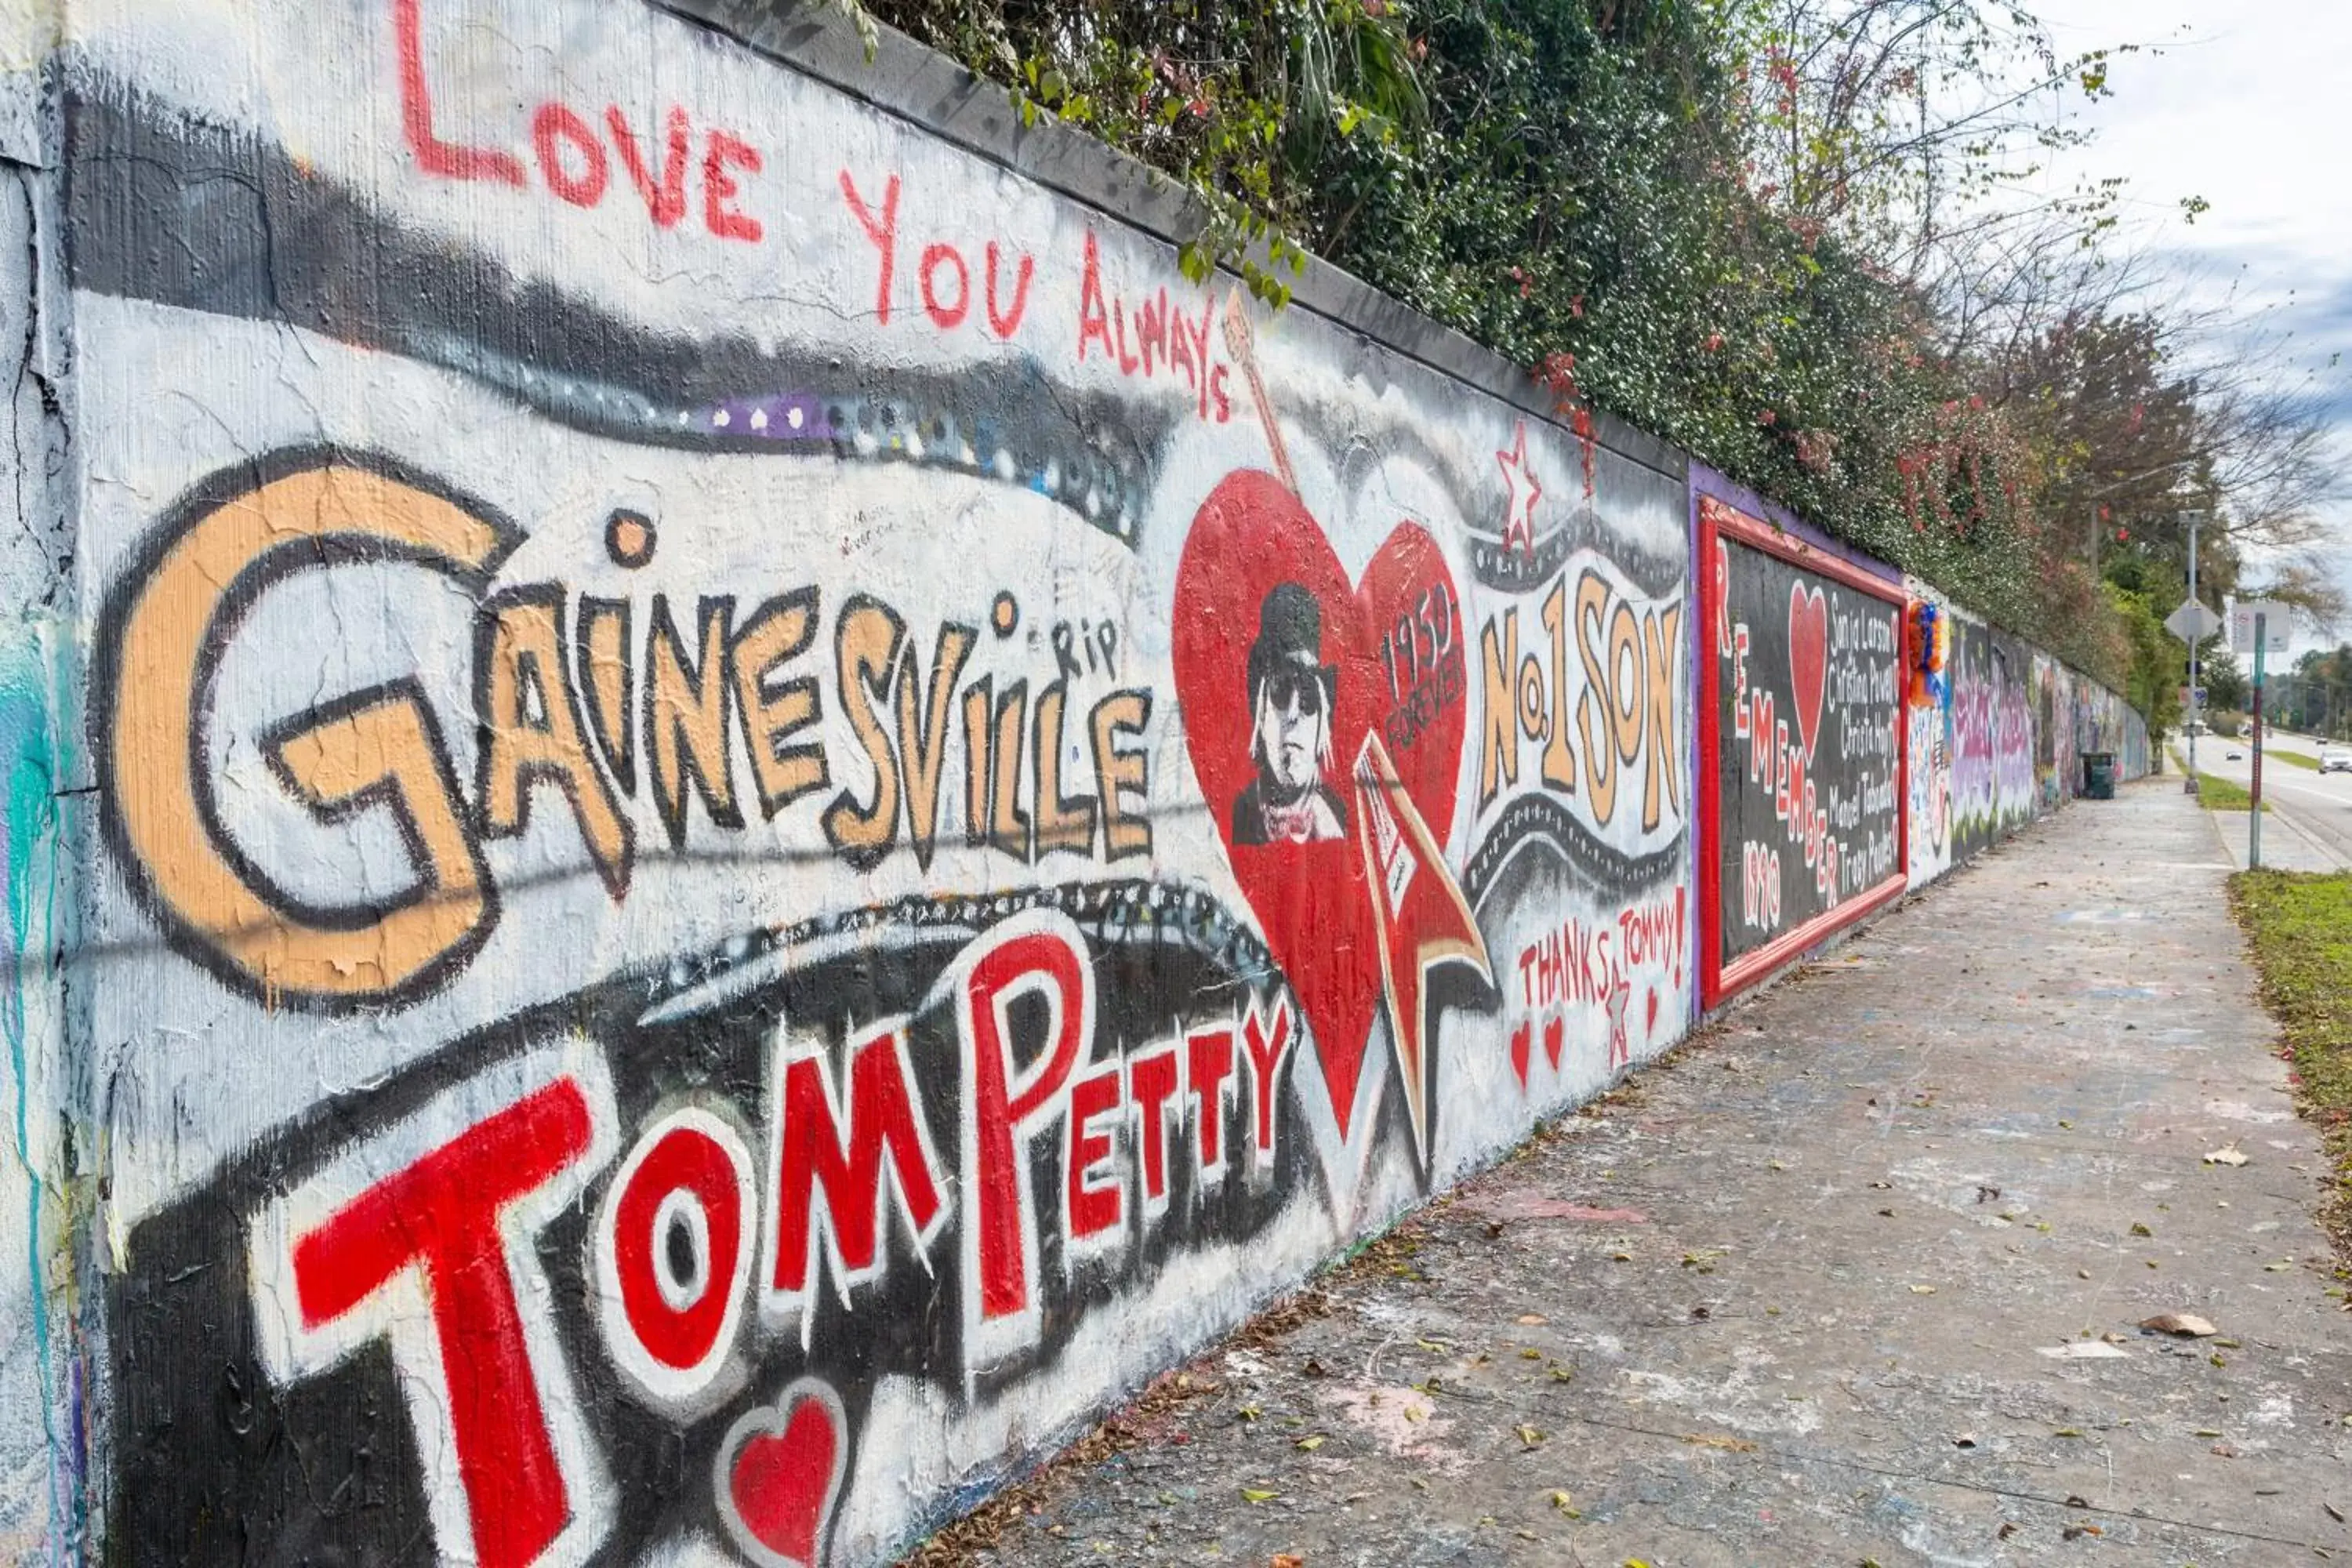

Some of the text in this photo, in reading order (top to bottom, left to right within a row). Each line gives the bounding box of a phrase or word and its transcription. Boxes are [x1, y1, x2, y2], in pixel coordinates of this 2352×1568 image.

[392, 0, 1231, 425] LOVE YOU ALWAYS
[1381, 581, 1452, 706] 1950
[1575, 566, 1682, 836] SON
[1716, 539, 1838, 910] REMEMBER
[1519, 885, 1686, 1008] THANKS TOMMY!
[1743, 840, 1780, 934] 1990
[248, 907, 1298, 1568] TOM PETTY
